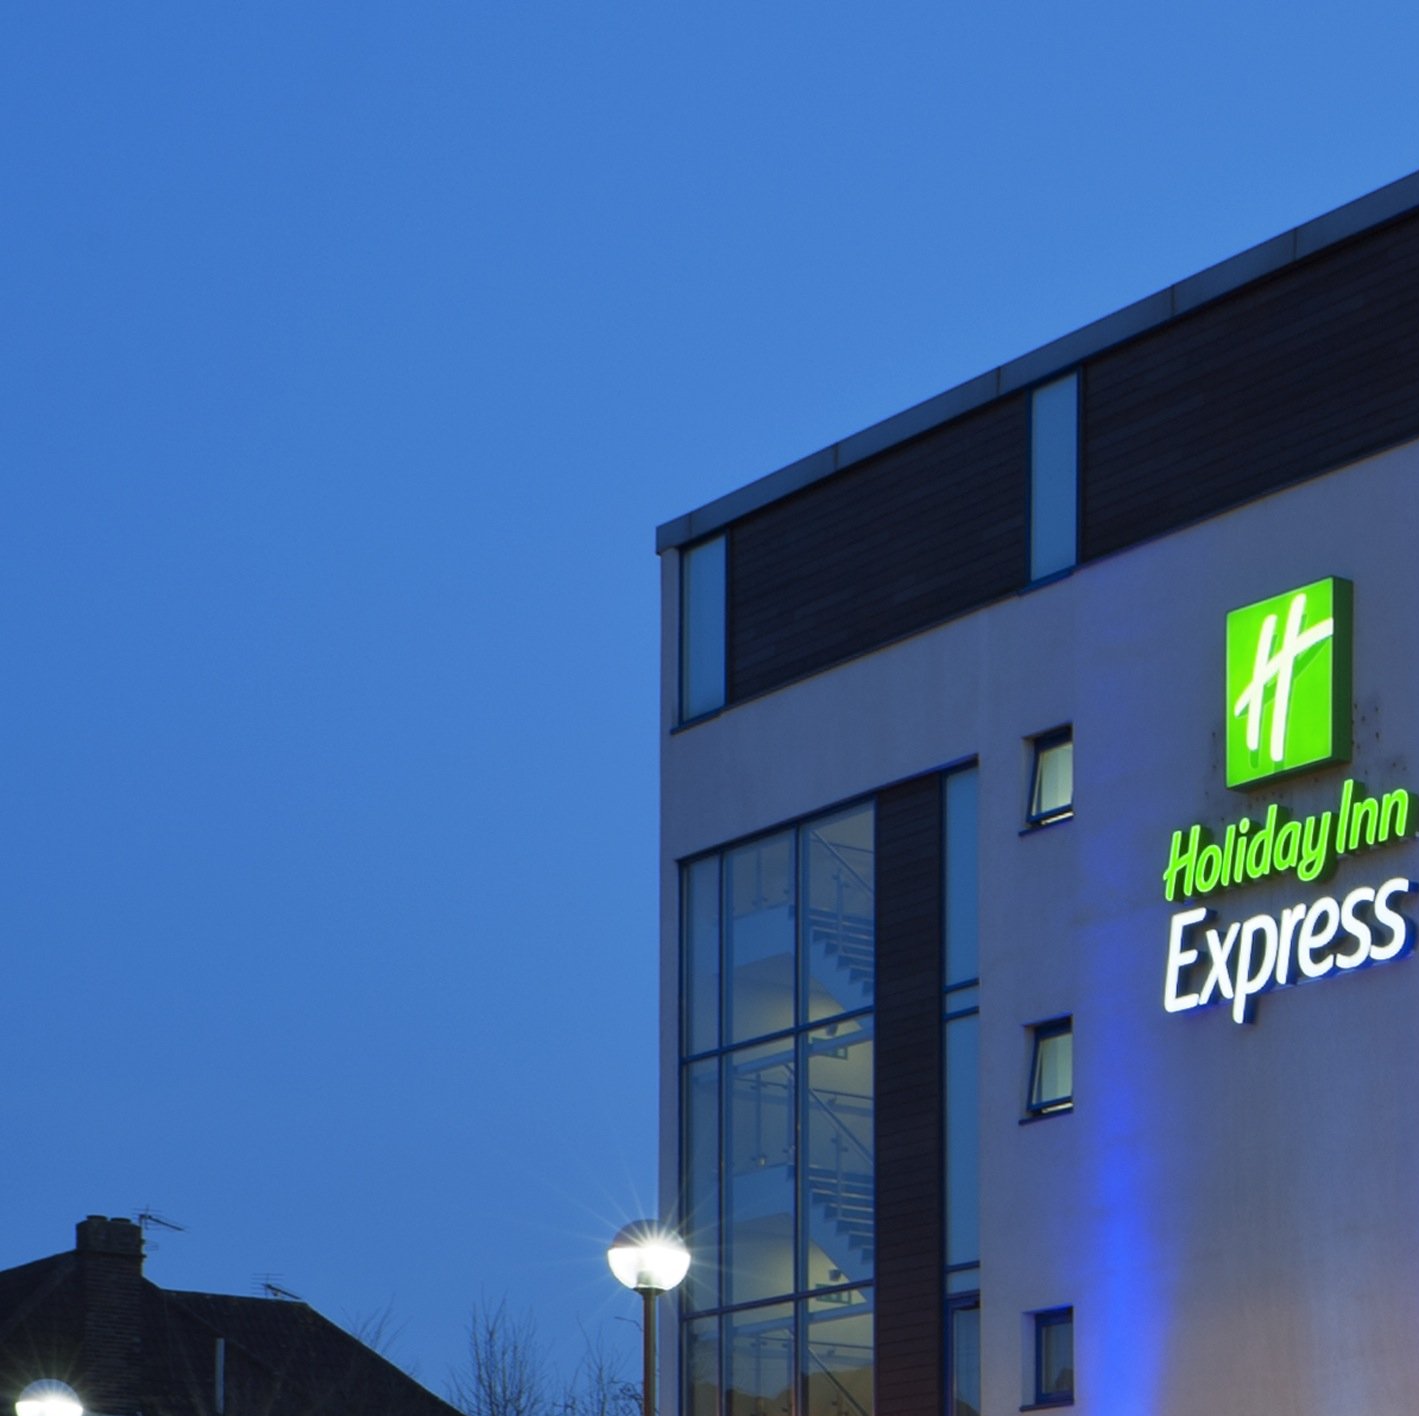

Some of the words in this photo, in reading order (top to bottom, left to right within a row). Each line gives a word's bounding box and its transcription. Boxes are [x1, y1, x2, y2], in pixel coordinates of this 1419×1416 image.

[1163, 804, 1331, 902] Holiday
[1336, 779, 1409, 854] Inn
[1164, 878, 1410, 1024] Express
